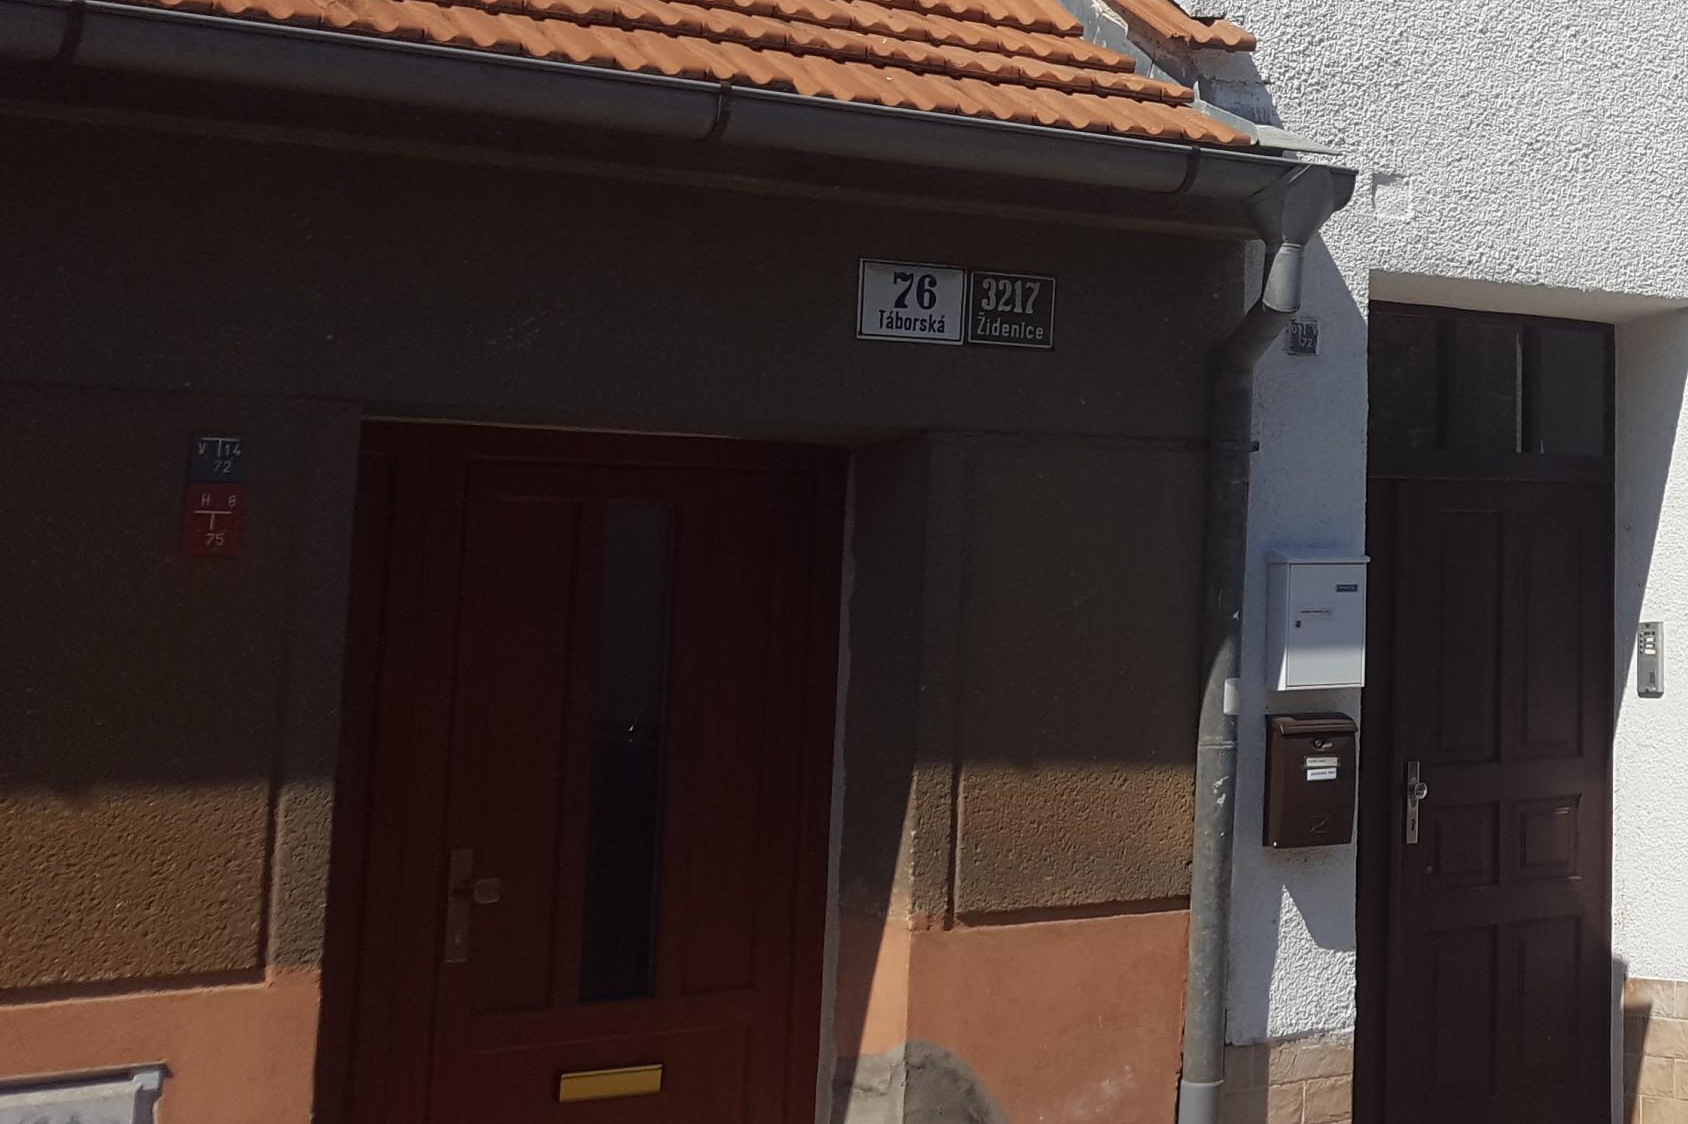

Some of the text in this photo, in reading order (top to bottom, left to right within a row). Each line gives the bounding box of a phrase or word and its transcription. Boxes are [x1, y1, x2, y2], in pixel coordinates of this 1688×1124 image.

[893, 271, 937, 309] 76
[982, 278, 1040, 314] 3217
[878, 309, 945, 333] Táborská
[977, 312, 1044, 340] Židenice
